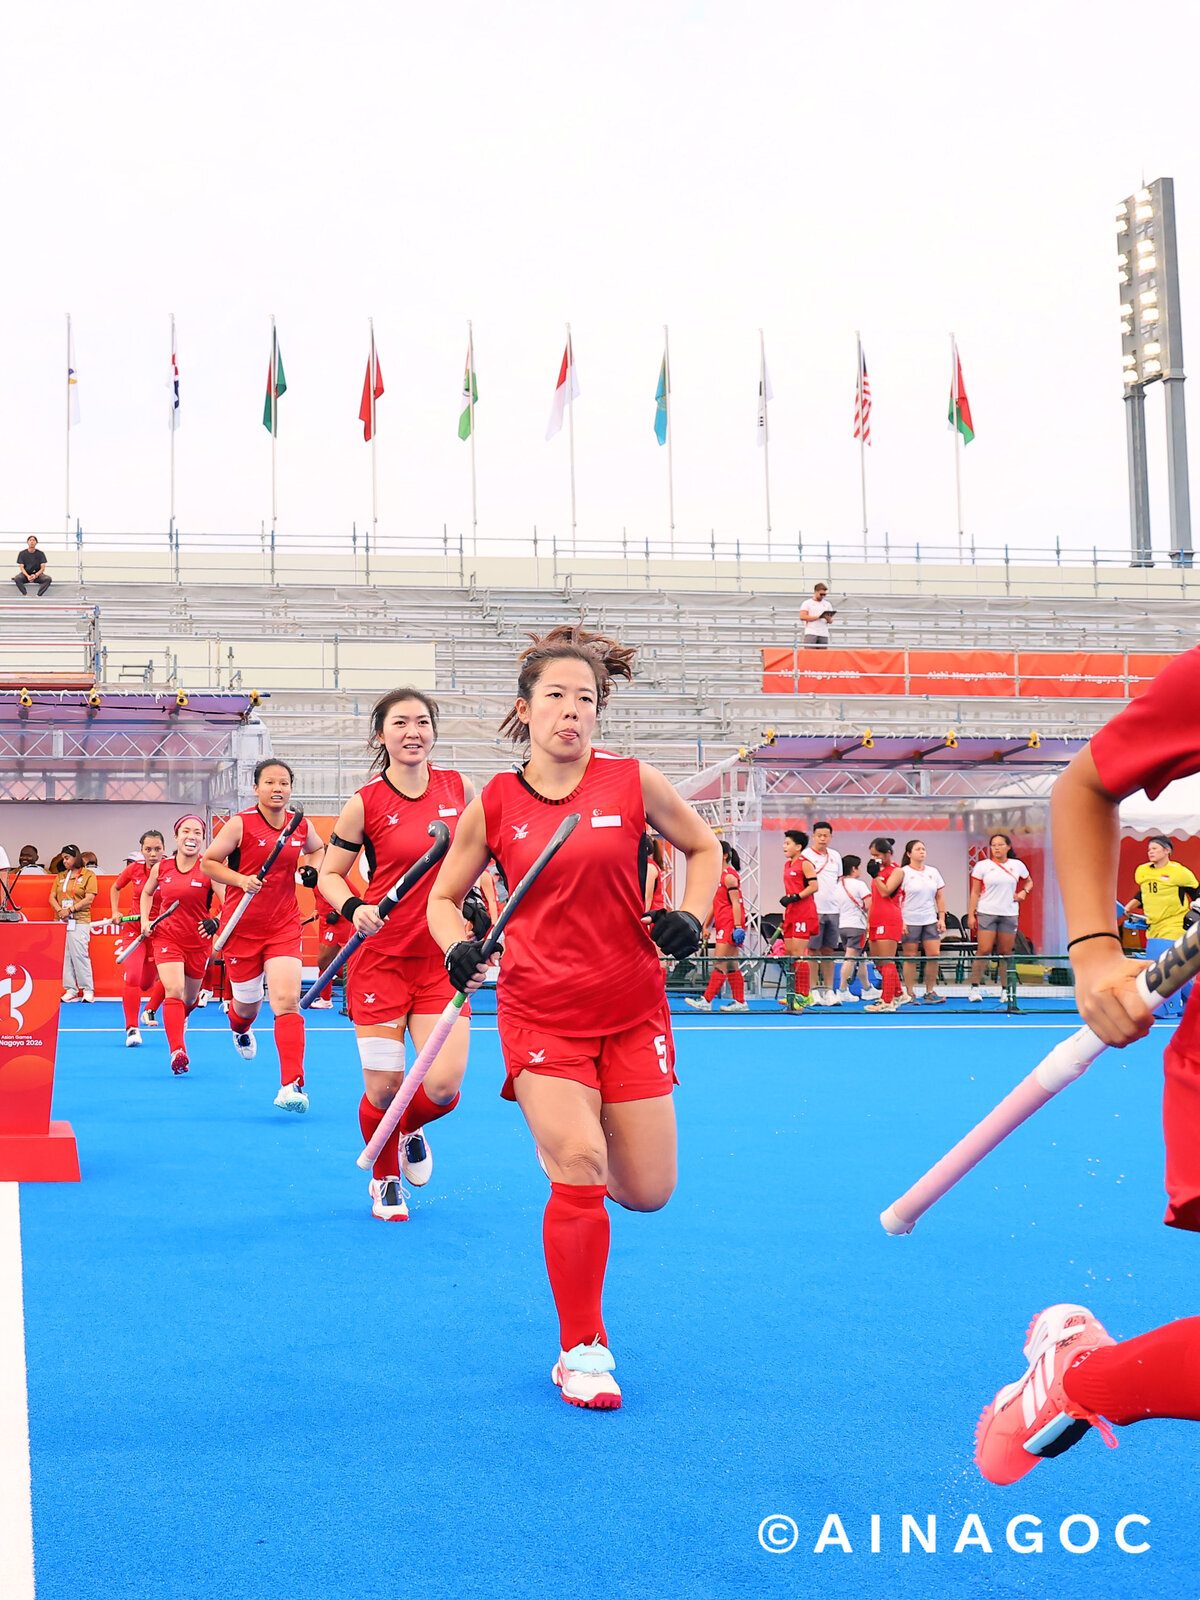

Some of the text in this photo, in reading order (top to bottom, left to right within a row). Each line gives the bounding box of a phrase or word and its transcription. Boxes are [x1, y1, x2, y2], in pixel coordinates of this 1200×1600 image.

[1148, 882, 1158, 894] 18
[795, 921, 807, 933] 24
[653, 1034, 669, 1075] 5
